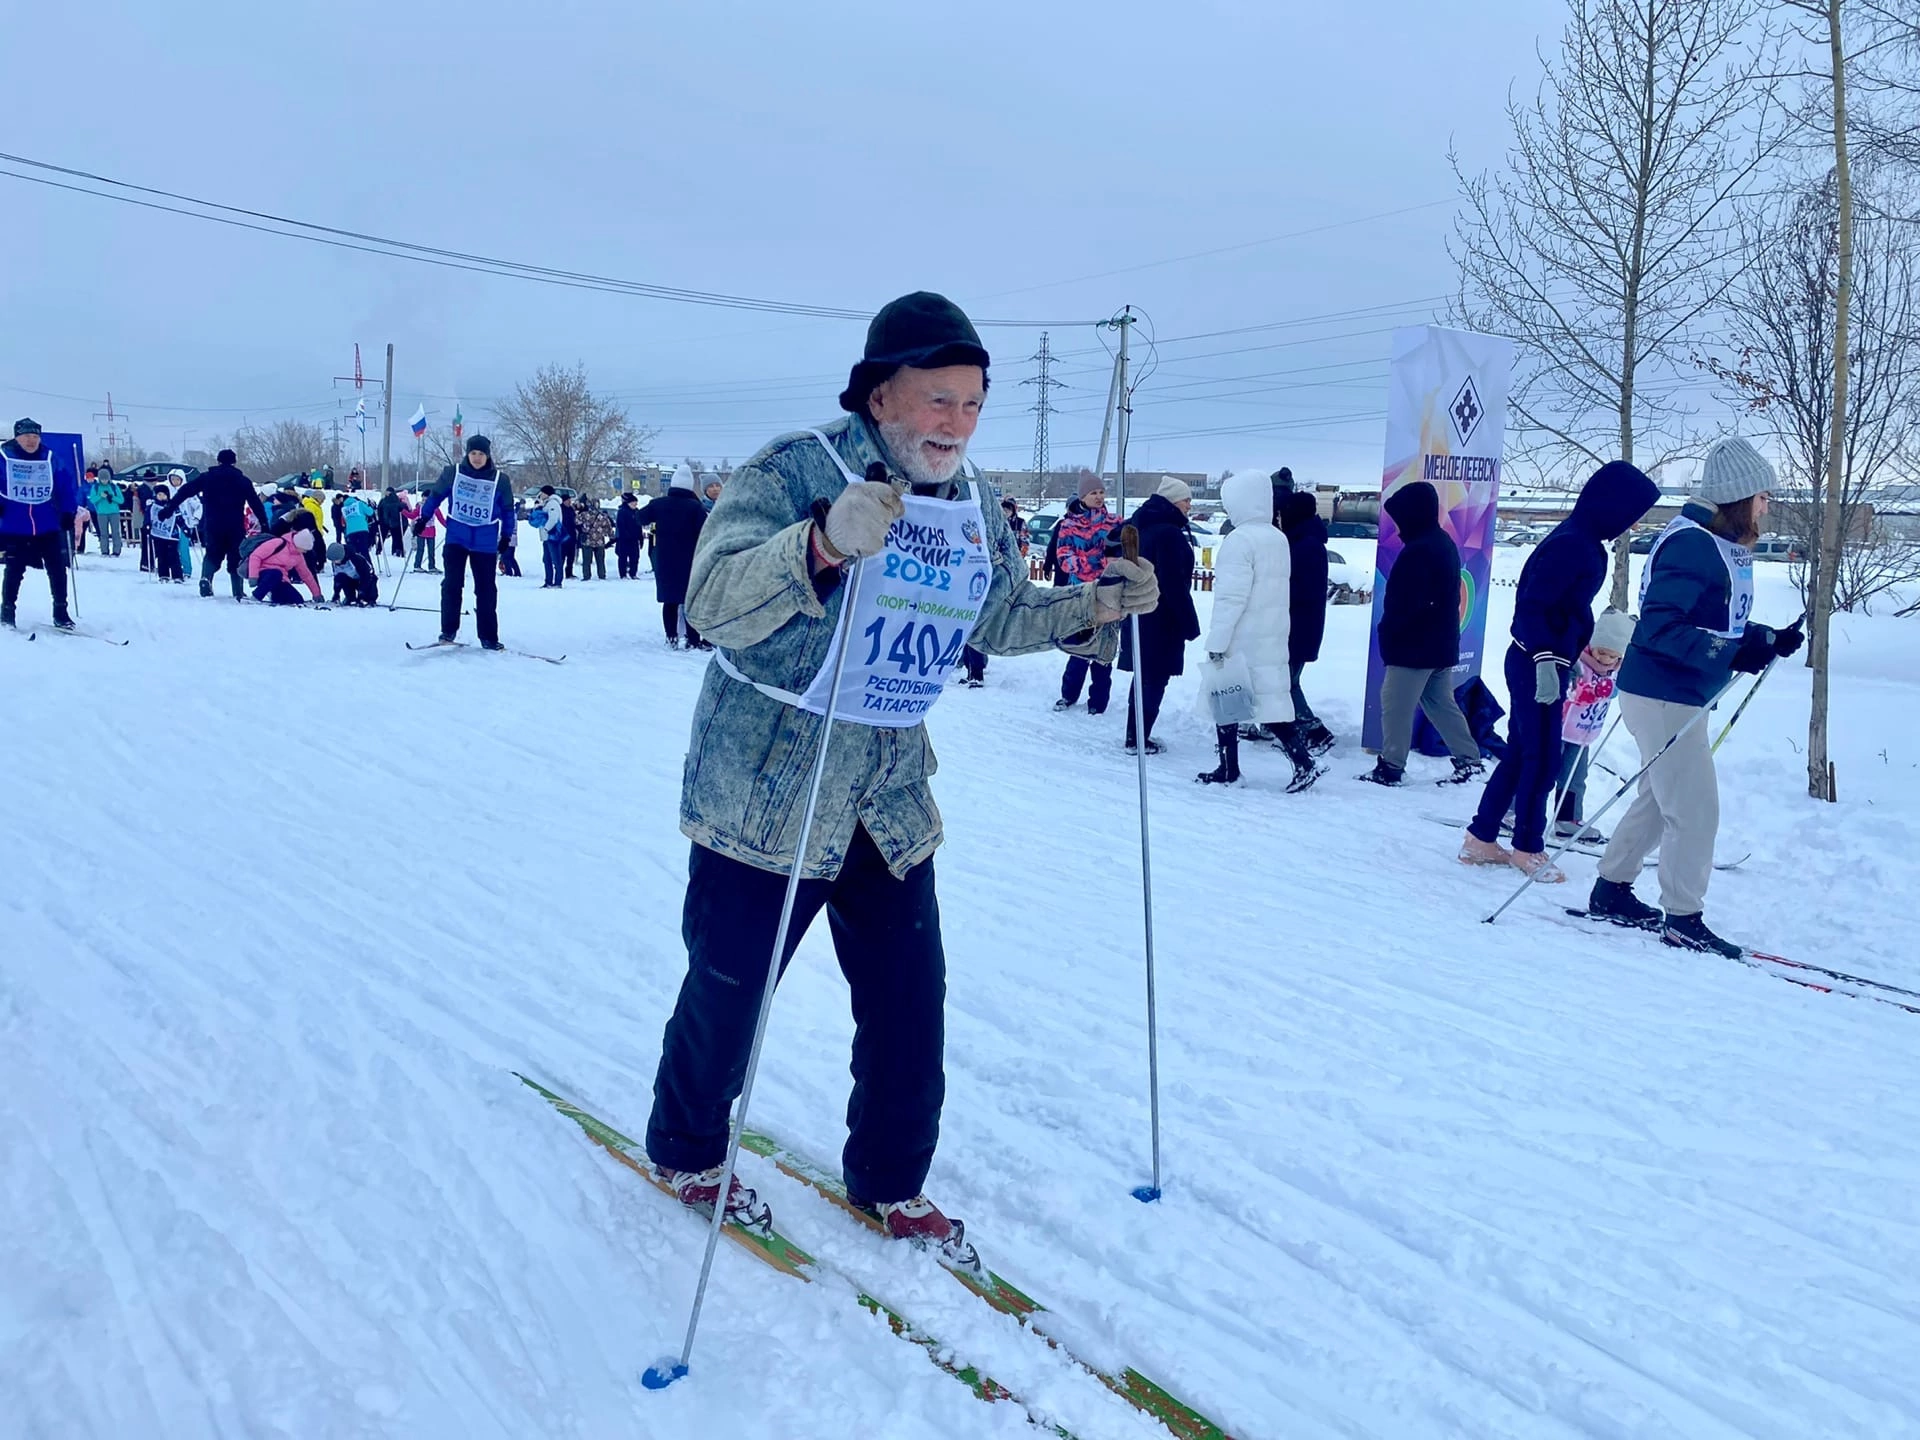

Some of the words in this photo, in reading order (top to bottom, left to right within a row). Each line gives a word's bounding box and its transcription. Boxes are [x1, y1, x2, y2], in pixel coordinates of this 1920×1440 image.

[1424, 454, 1497, 481] МЕНДЕЛЕЕВСК
[12, 486, 51, 498] 14155
[455, 502, 489, 519] 14193
[889, 519, 950, 547] ЫЖНЯ
[882, 553, 952, 592] 2022
[876, 594, 909, 611] СПОРТ
[1211, 684, 1242, 697] MANGO
